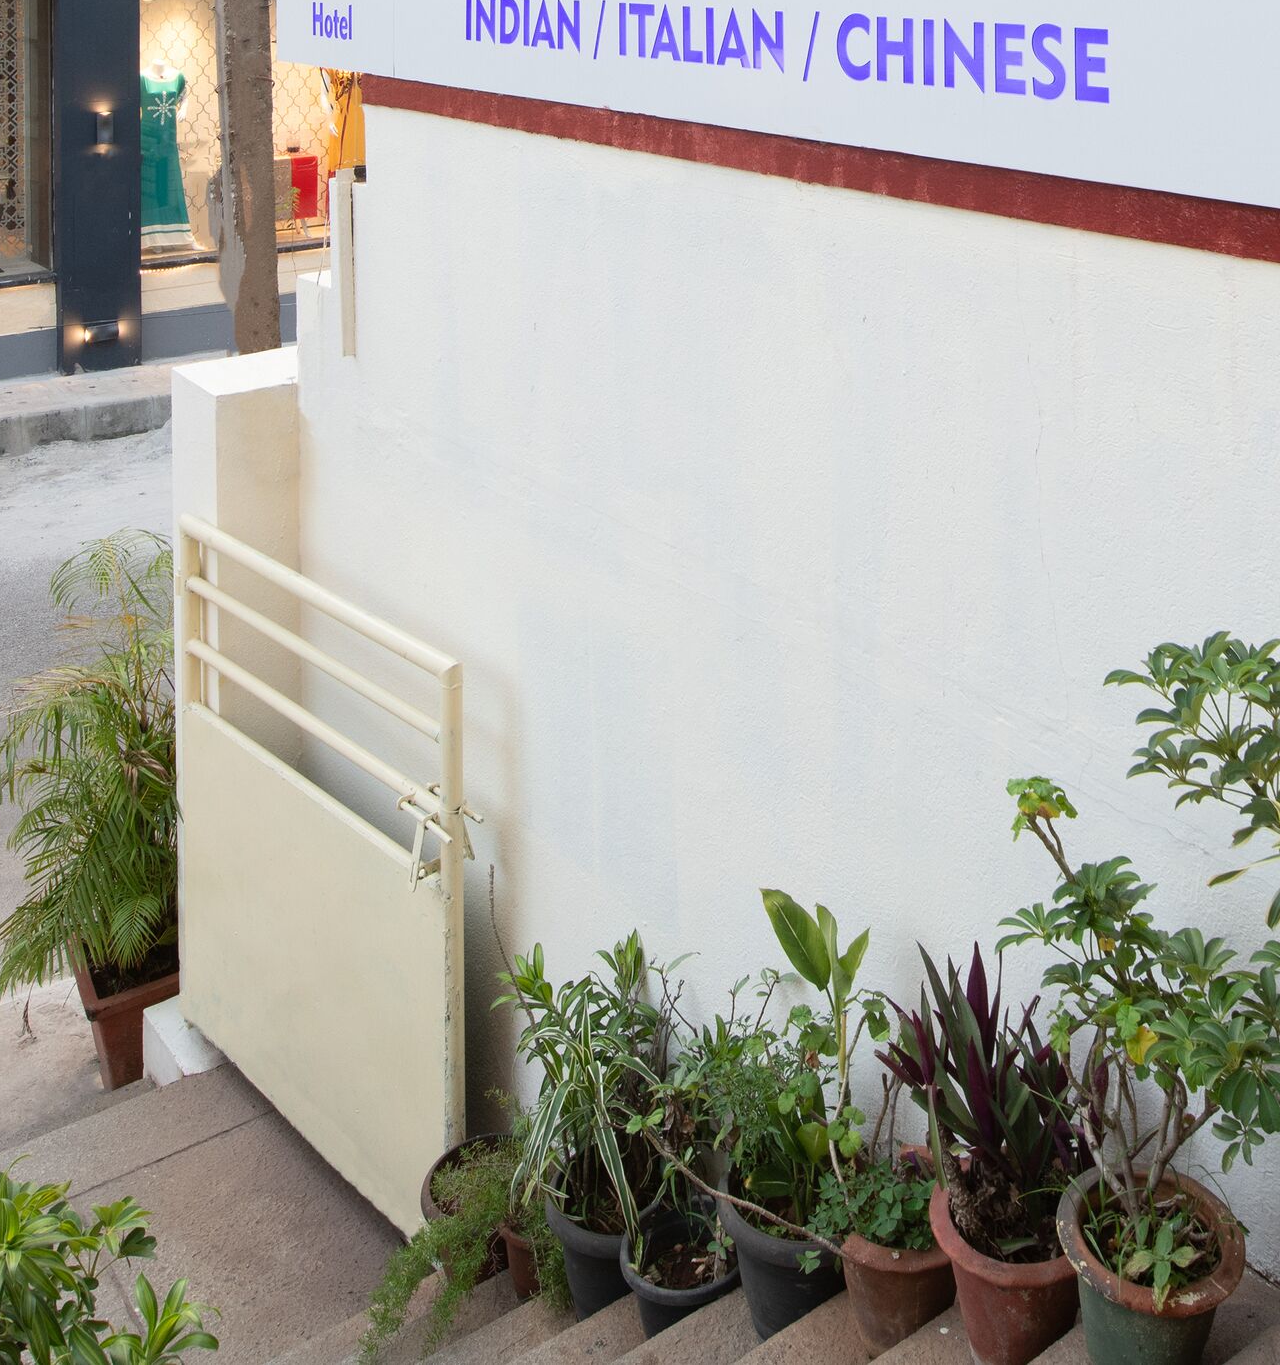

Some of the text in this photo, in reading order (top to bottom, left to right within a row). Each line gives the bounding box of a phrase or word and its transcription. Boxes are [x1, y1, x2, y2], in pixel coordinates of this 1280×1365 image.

[312, 1, 354, 42] Hotel
[618, 2, 785, 73] ITALIAN
[836, 12, 1110, 105] CHINESE
